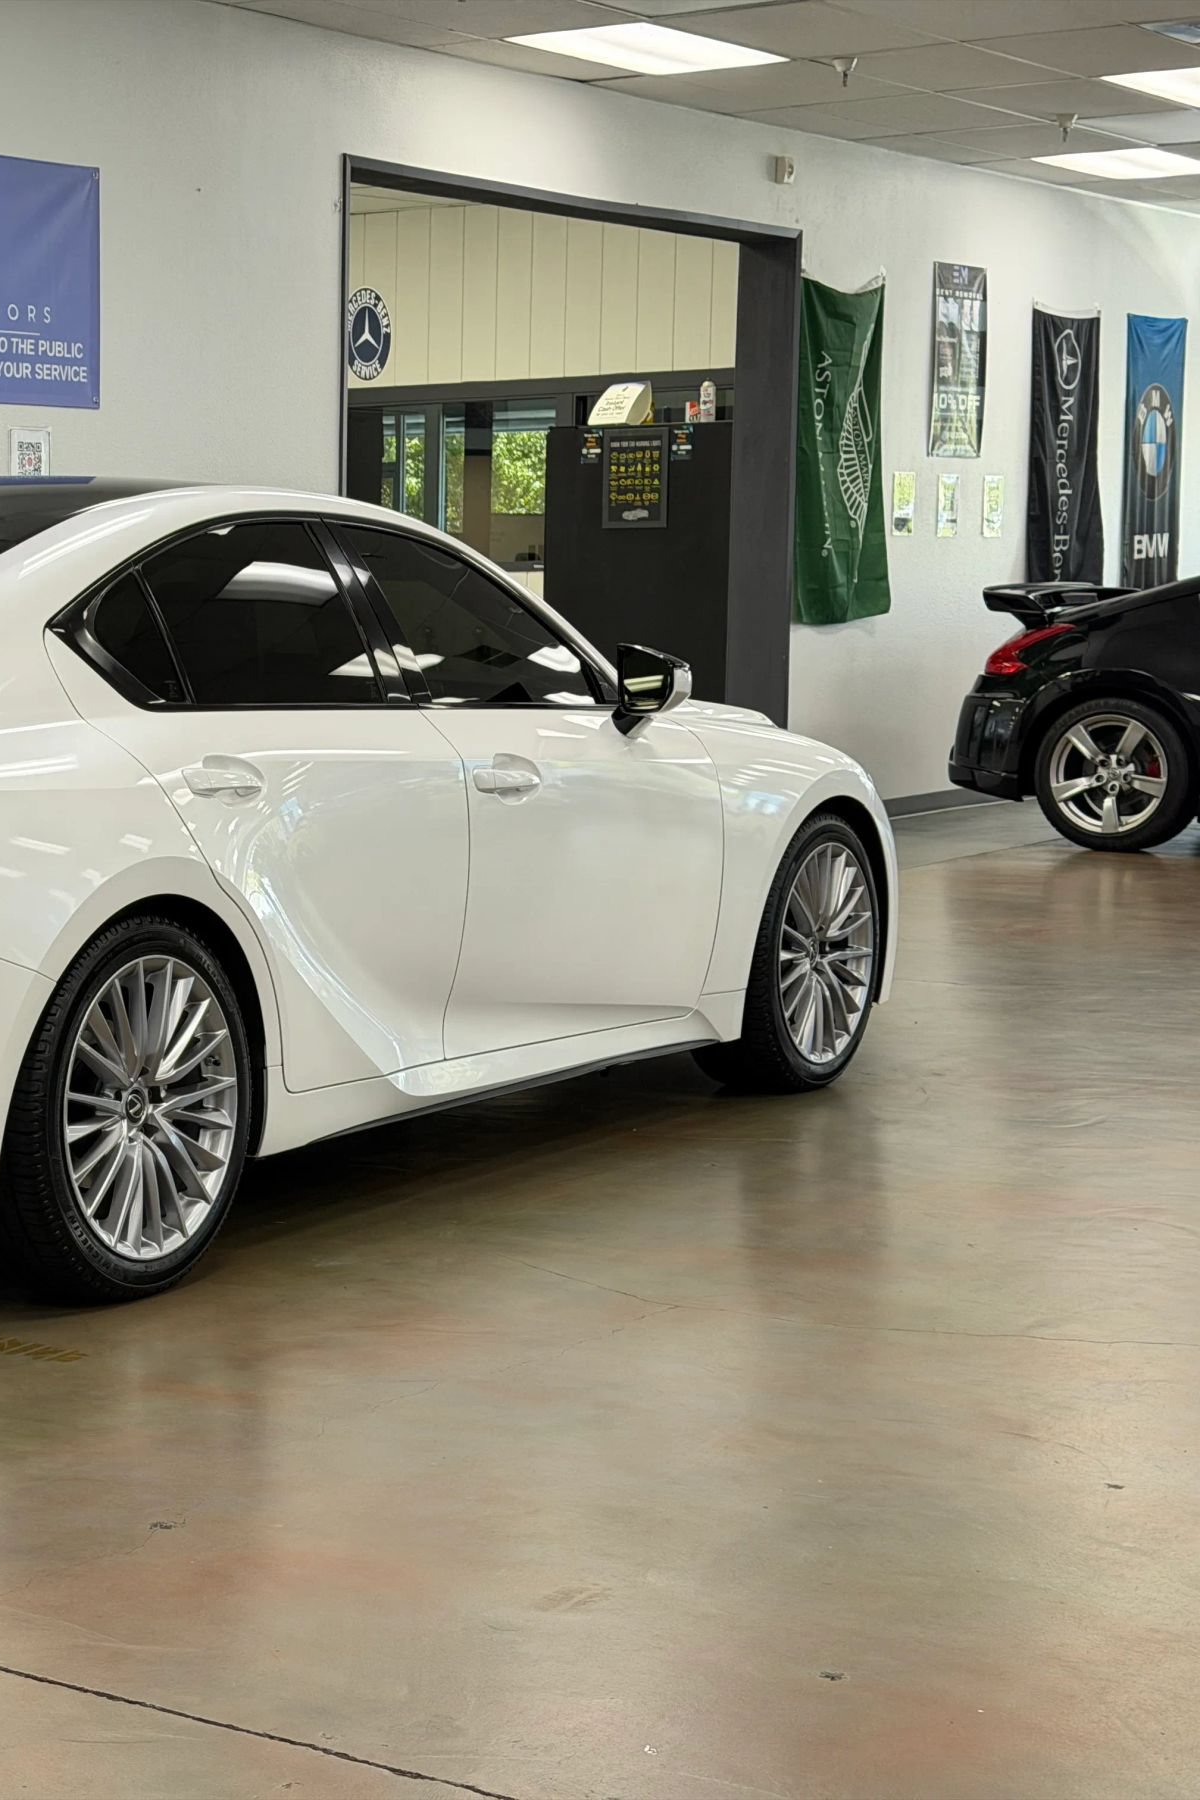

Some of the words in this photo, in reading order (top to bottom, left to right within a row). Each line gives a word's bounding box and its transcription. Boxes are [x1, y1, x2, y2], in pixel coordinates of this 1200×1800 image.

[11, 338, 35, 355] THE
[38, 340, 84, 359] PUBLIC
[34, 365, 88, 383] SERVICE
[353, 359, 382, 380] SERVICE
[814, 351, 832, 441] ASTON
[1052, 396, 1075, 582] Mercedes-Ben
[1134, 533, 1170, 560] BMW
